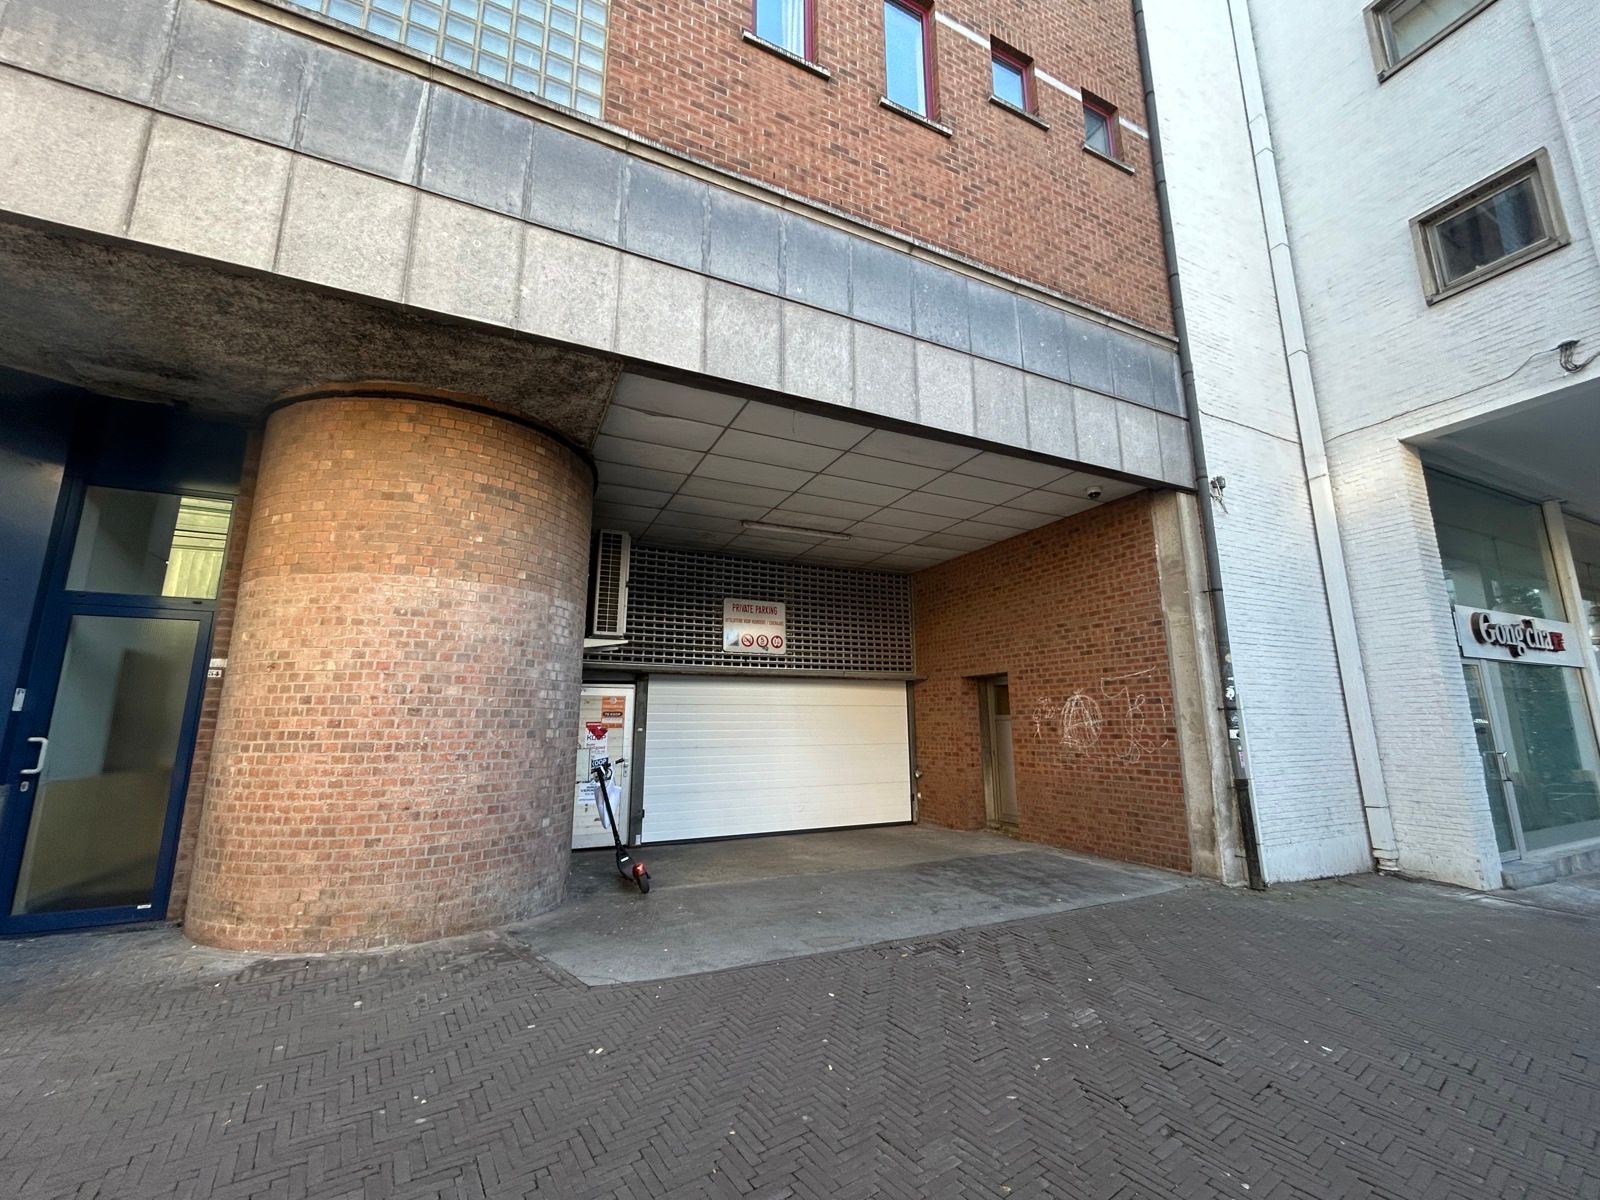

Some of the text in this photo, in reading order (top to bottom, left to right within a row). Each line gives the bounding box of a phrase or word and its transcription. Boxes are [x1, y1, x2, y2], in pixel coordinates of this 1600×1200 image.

[732, 603, 778, 615] PRIVATE PARKING
[1472, 612, 1554, 656] Gong cha
